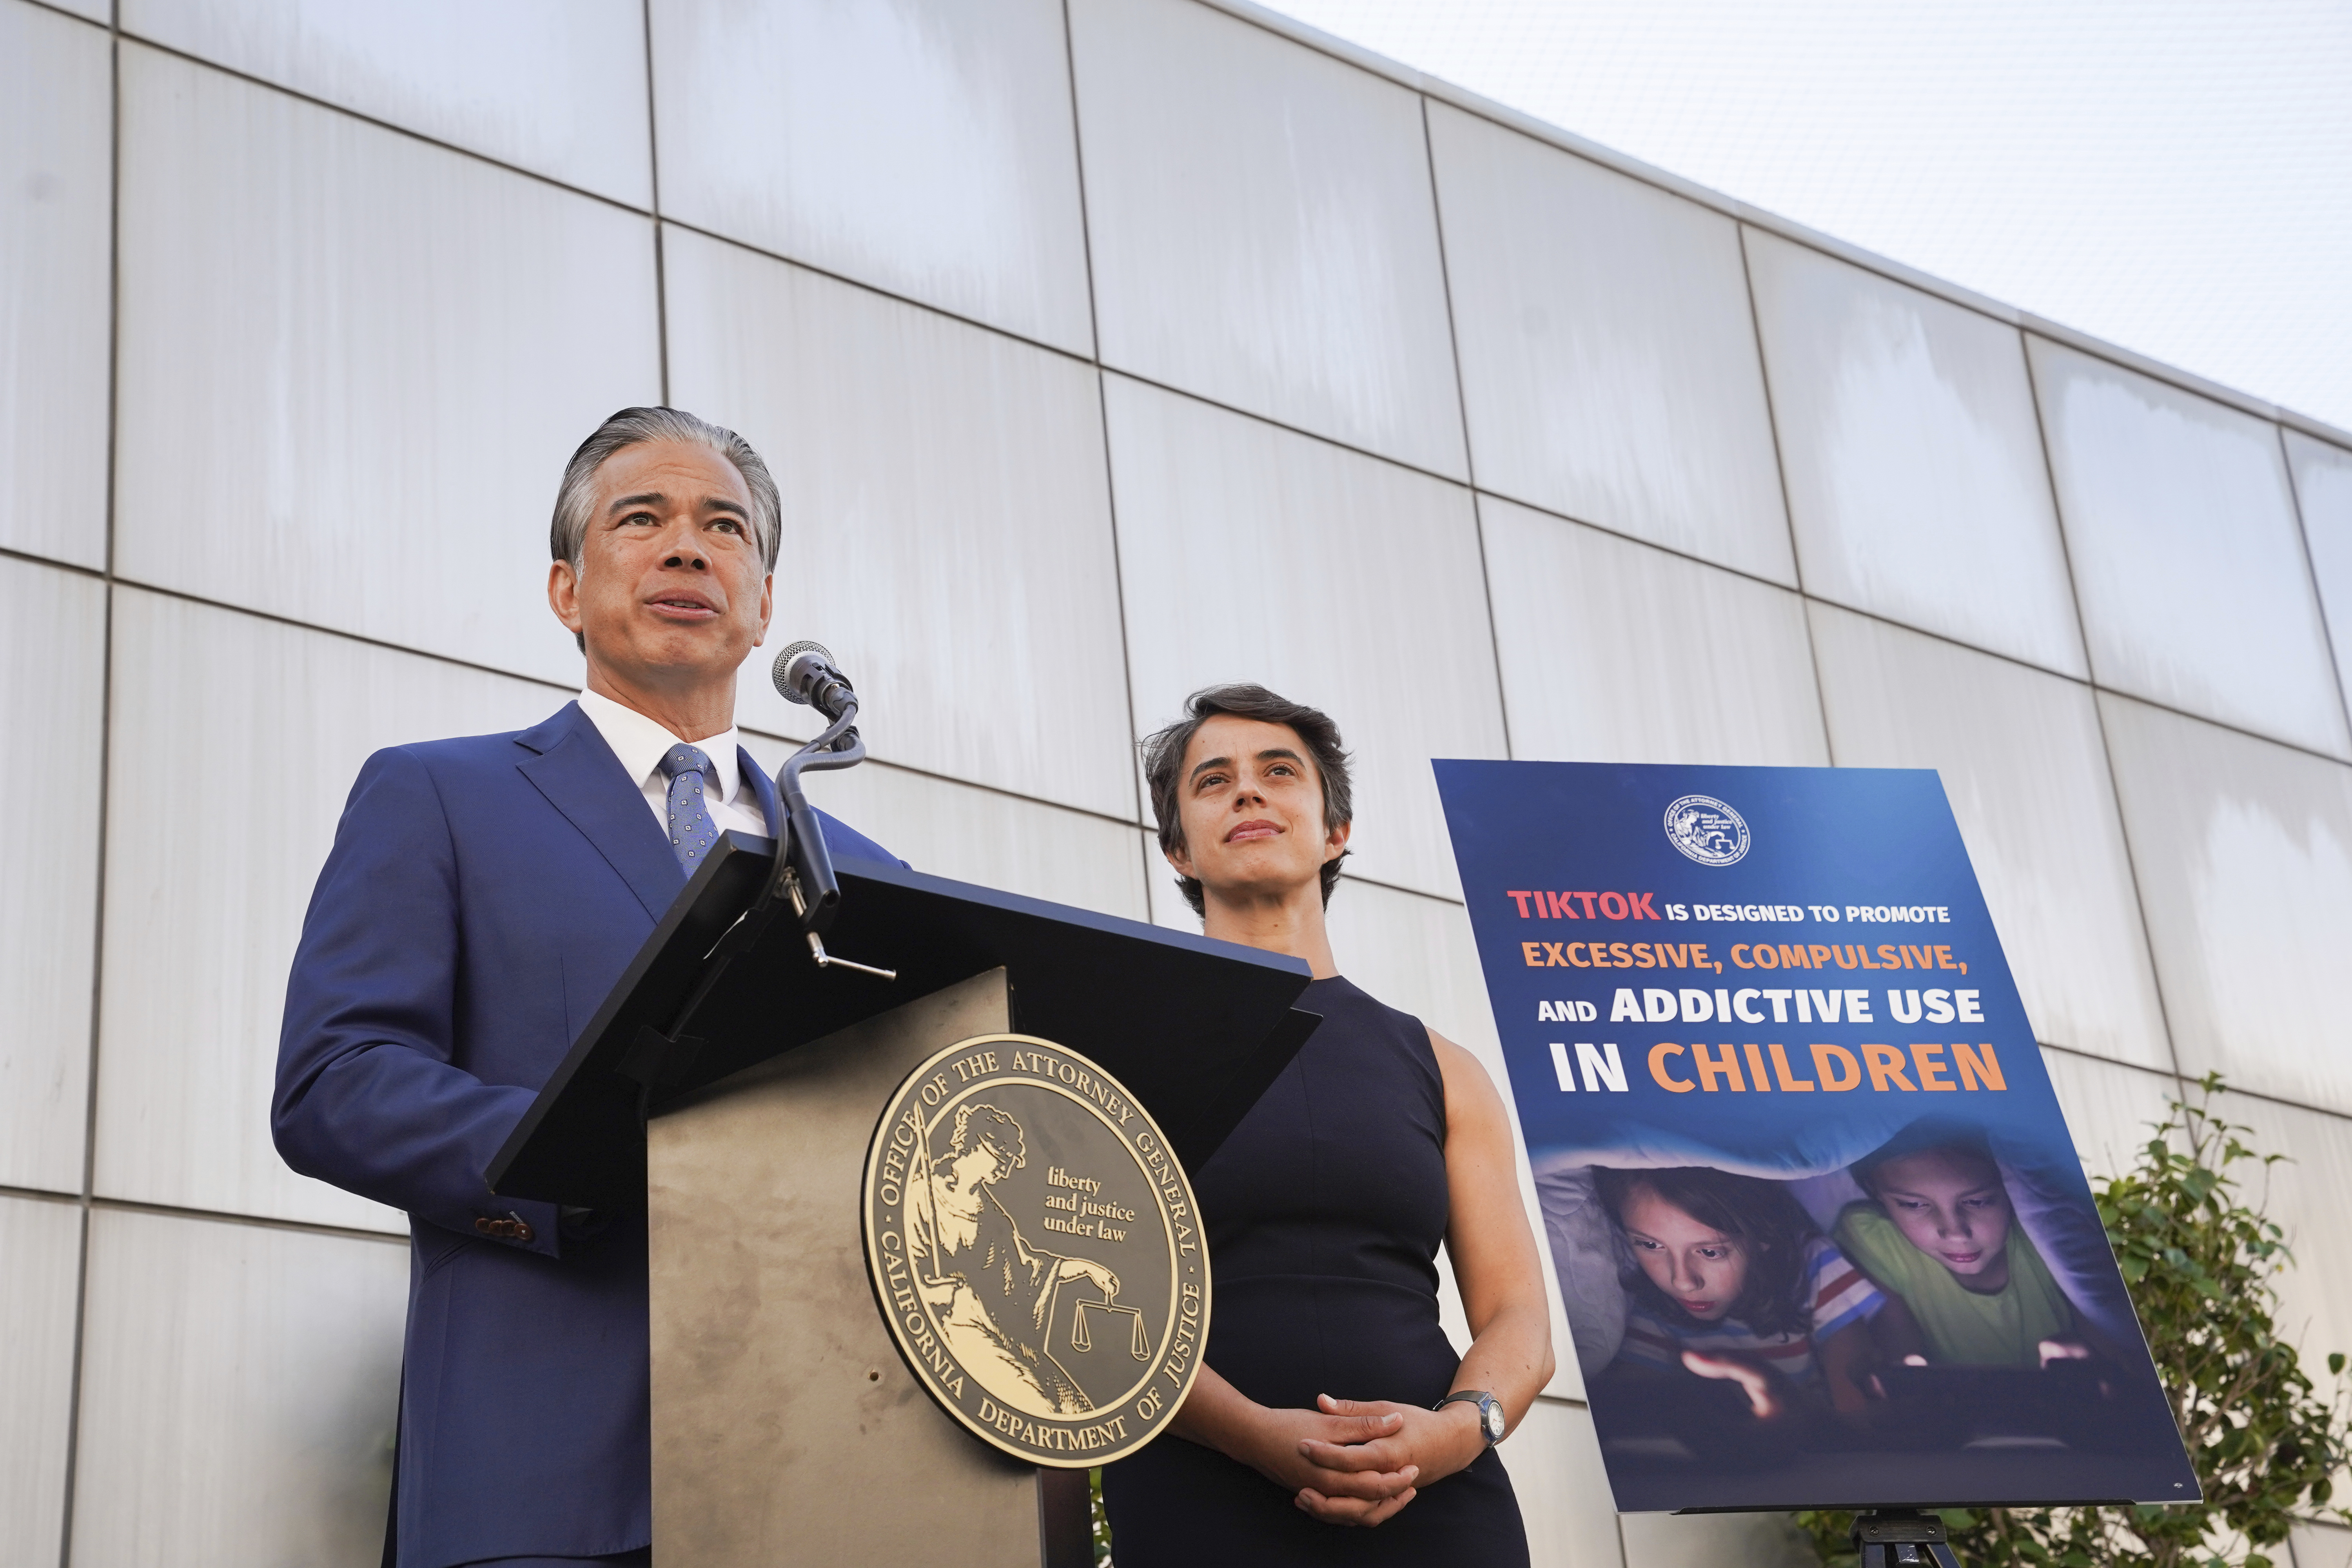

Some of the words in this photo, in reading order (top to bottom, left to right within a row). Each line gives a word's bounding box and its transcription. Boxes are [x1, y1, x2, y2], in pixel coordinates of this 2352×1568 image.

[1691, 797, 1722, 808] ATTORNEY
[1722, 806, 1743, 828] GENERAL
[1670, 833, 1697, 859] CALIFORNIA
[1698, 855, 1734, 864] DEPARTMENT
[1507, 891, 1661, 920] TIKTOK
[1665, 904, 1689, 921] IS
[1693, 904, 1804, 922] DESIGNED
[1808, 906, 1840, 922] TO
[1846, 906, 1951, 923] PROMOTE
[1521, 942, 1722, 974] EXCESSIVE,
[1731, 944, 1967, 975] COMPULSIVE,
[1538, 1000, 1597, 1022] AND
[1610, 988, 1874, 1024] ADDICTIVE
[1887, 989, 1985, 1024] USE
[1549, 1043, 1629, 1092] IN
[1648, 1043, 2007, 1093] CHILDREN
[880, 1111, 918, 1206] OFFICE
[921, 1073, 949, 1105] OF
[951, 1051, 1000, 1082] THE
[1012, 1051, 1134, 1126] ATTORNEY
[1136, 1132, 1196, 1257] GENERAL
[1047, 1166, 1102, 1194] liberty
[1045, 1192, 1078, 1212] and
[1079, 1198, 1135, 1221] justice
[1044, 1214, 1094, 1237] under
[1098, 1219, 1127, 1242] law
[881, 1230, 963, 1400] CALIFORNIA
[977, 1397, 1128, 1451] DEPARTMENT
[1136, 1386, 1163, 1421] OF
[1163, 1282, 1200, 1388] JUSTICE
